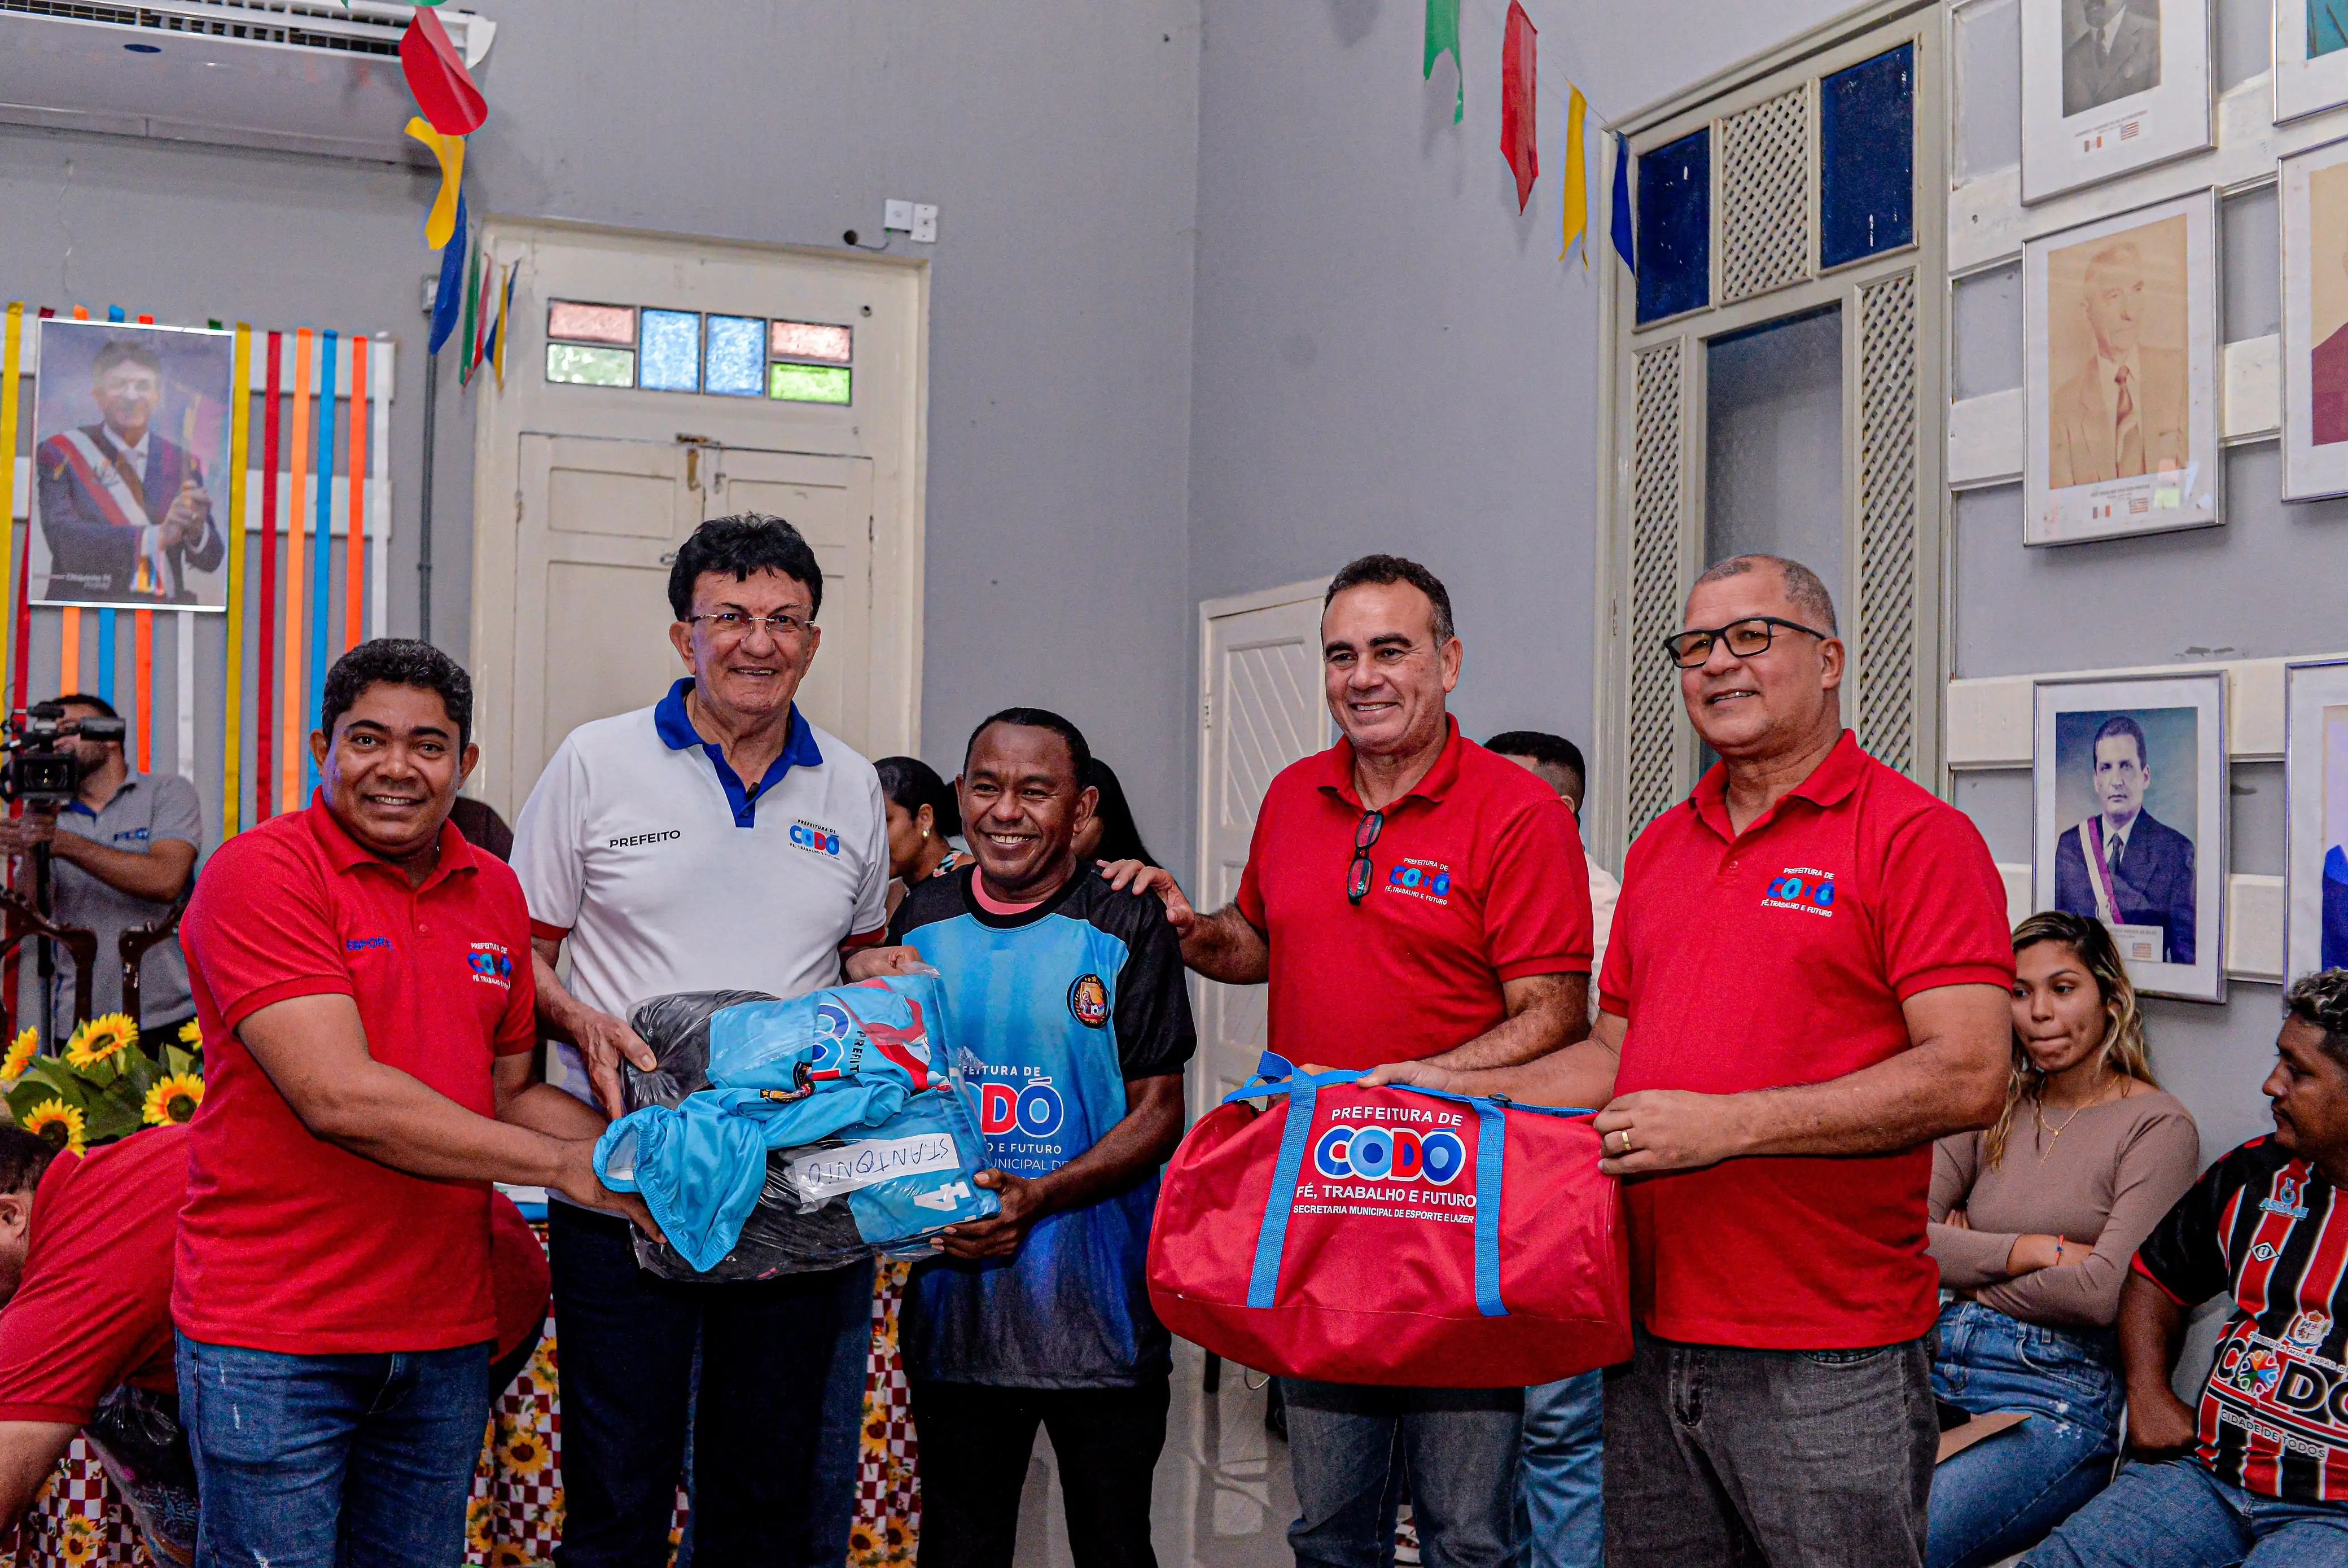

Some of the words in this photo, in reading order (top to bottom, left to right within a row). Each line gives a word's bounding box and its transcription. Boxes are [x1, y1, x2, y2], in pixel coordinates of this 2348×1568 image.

[798, 819, 828, 831] PREFEITURA
[610, 830, 681, 848] PREFEITO
[1403, 857, 1438, 869] PREFEITURA
[1783, 867, 1823, 876] PREFEITURA
[1392, 887, 1420, 897] TRABALHO
[1425, 895, 1447, 905] FUTURO
[1807, 906, 1833, 917] FUTURO
[1023, 1066, 1040, 1076] DE
[1331, 1106, 1433, 1123] PREFEITURA
[1438, 1113, 1463, 1127] DE
[998, 1143, 1005, 1152] E
[1010, 1144, 1062, 1154] FUTURO
[1314, 1124, 1466, 1186] CODÓ
[1295, 1182, 1317, 1200] FÉ,
[1322, 1185, 1405, 1202] TRABALHO
[1408, 1189, 1418, 1203] E
[1422, 1191, 1477, 1208] FUTURO
[1293, 1205, 1347, 1214] SECRETARIA
[1349, 1206, 1393, 1217] MUNICIPAL
[1394, 1209, 1404, 1218] DE
[1405, 1210, 1443, 1221] ESPORTE
[1444, 1214, 1449, 1222] E
[1450, 1214, 1474, 1224] LAZER
[2289, 1349, 2337, 1368] MUNICIPAL
[2221, 1411, 2260, 1433] CIDADE
[2263, 1428, 2279, 1440] DE
[2283, 1435, 2326, 1458] TODOS
